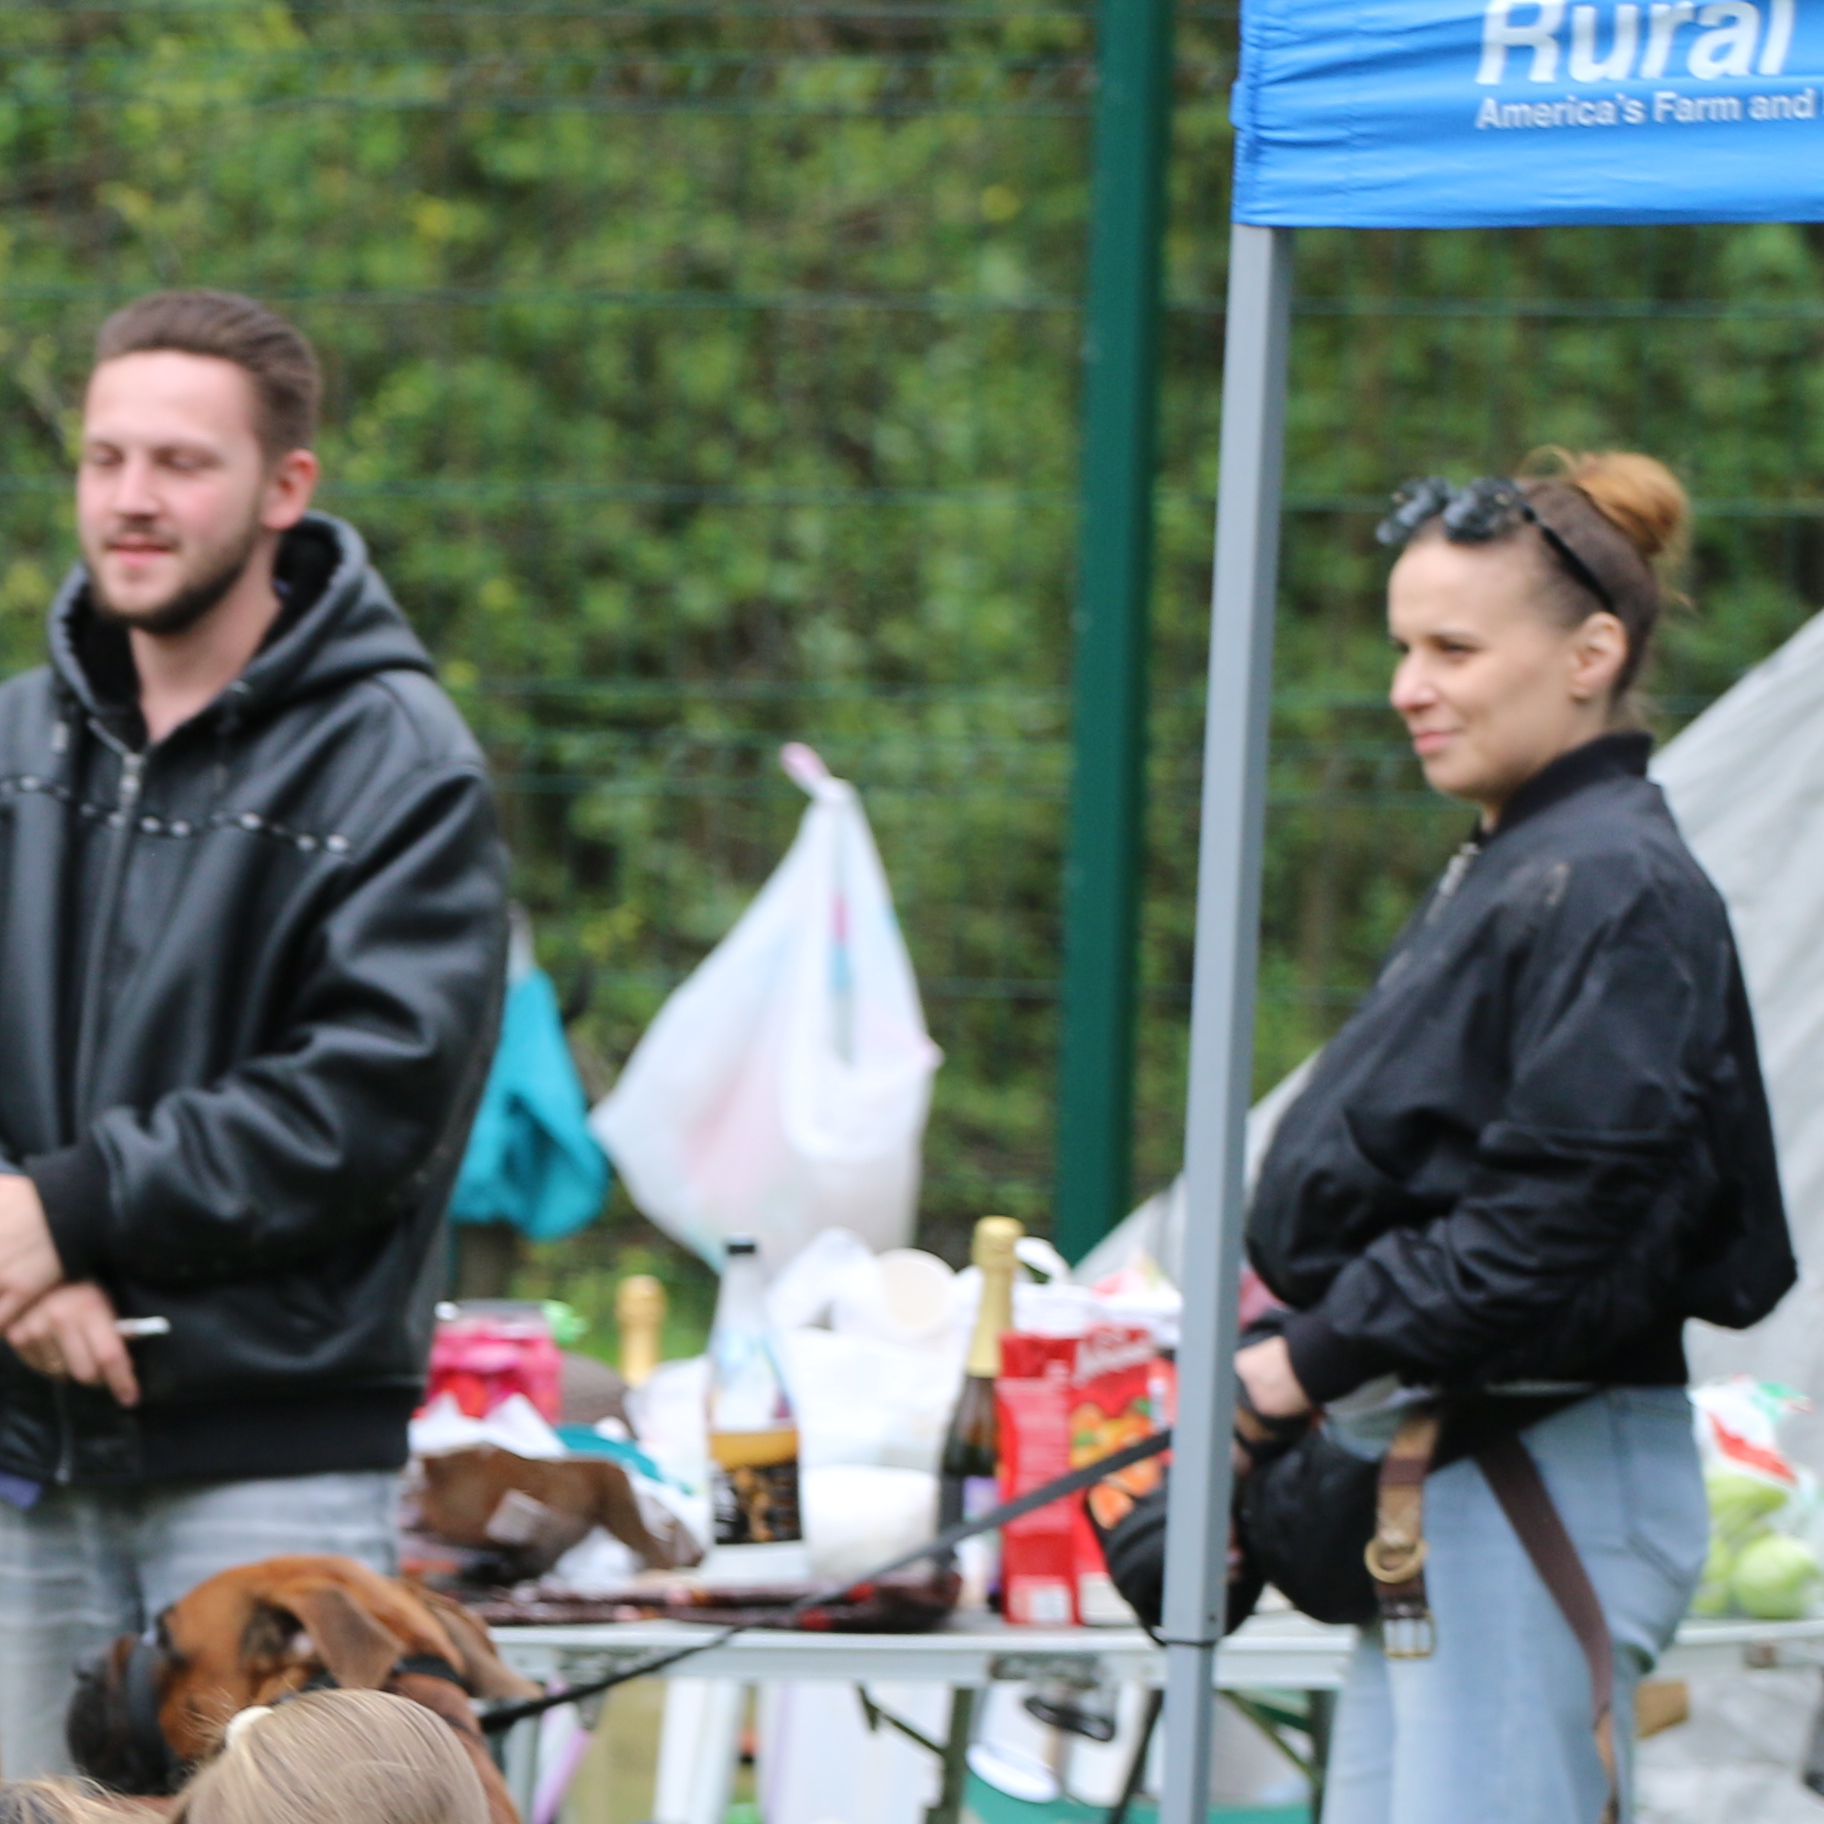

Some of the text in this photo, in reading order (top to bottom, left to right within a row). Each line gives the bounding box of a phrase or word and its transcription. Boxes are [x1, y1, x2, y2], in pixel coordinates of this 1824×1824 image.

[1474, 0, 1795, 85] Rural
[1474, 86, 1818, 129] America's Farm and
